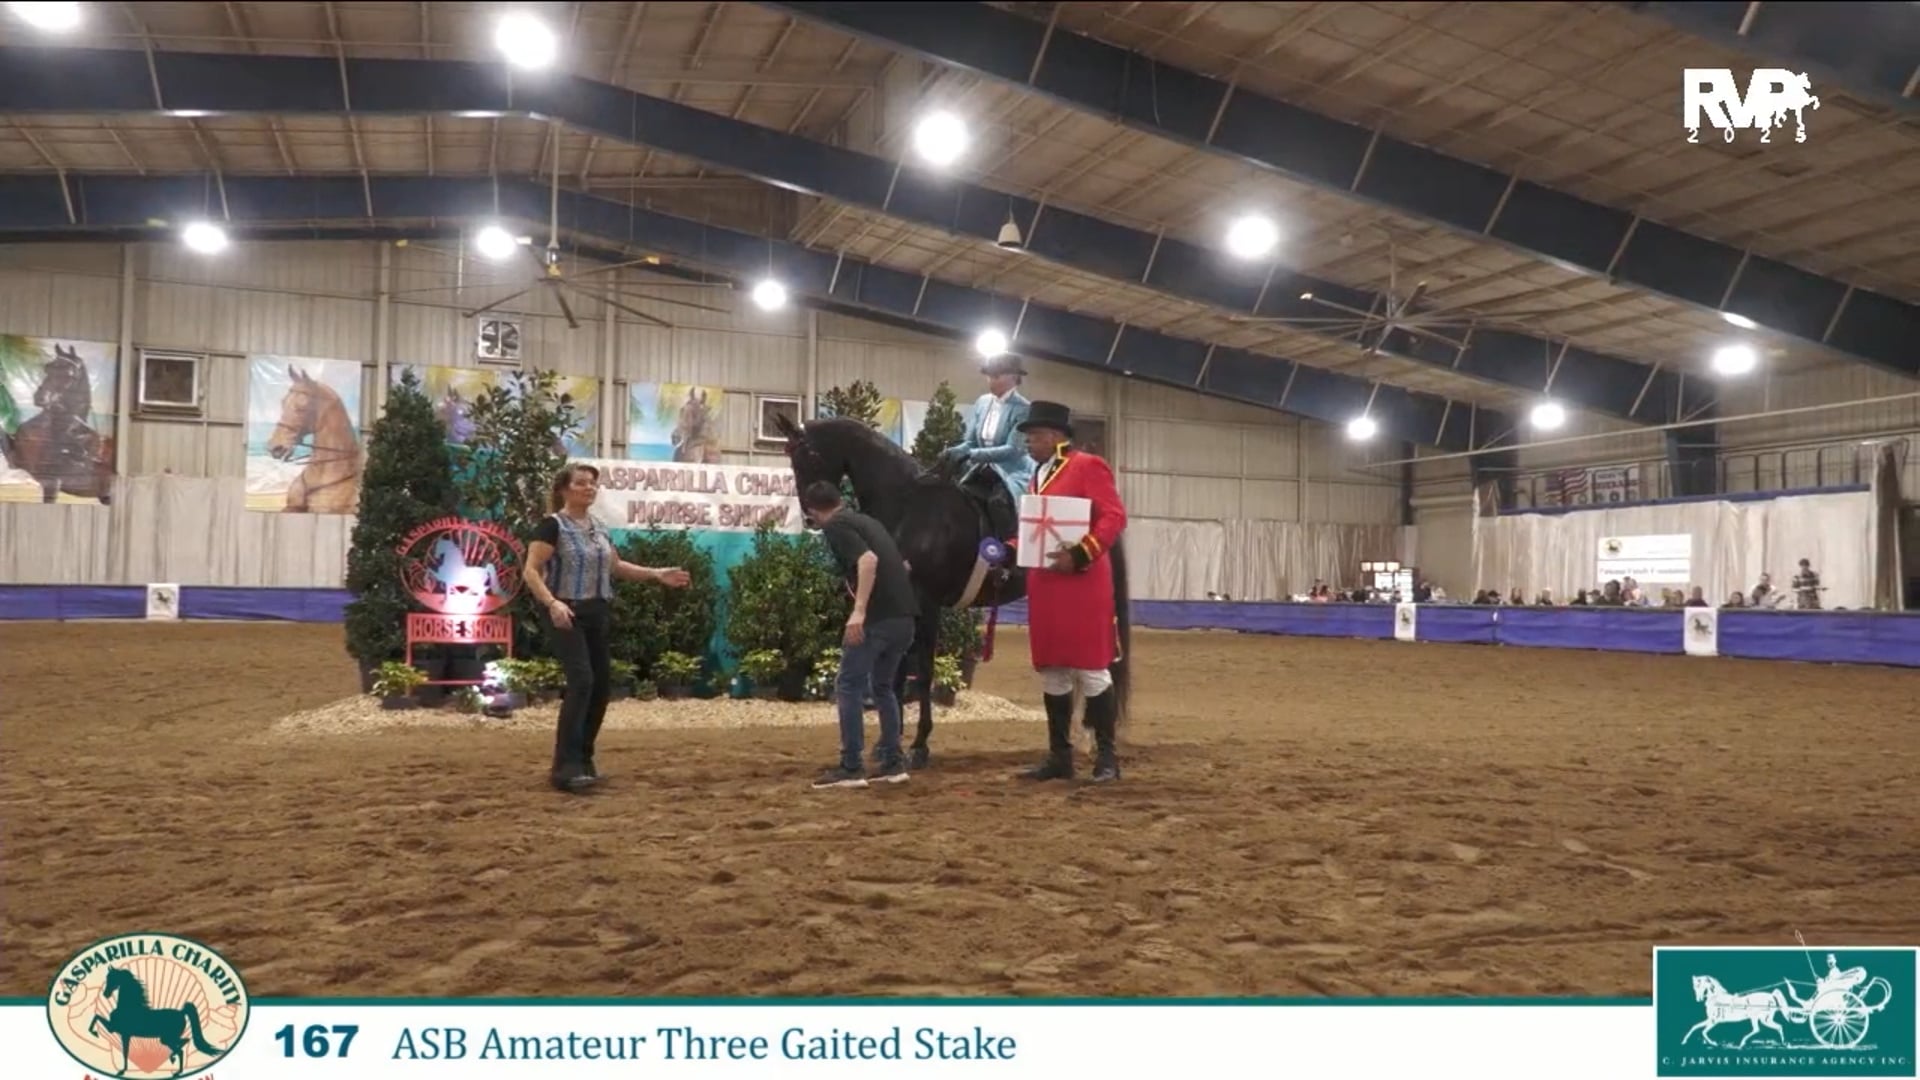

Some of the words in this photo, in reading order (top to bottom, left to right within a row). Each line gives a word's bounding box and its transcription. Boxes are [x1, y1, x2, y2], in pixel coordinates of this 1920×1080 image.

[597, 465, 729, 495] ASPARILLA
[735, 471, 799, 497] CHAR
[627, 500, 712, 526] HORSE
[718, 502, 790, 528] SHOW
[411, 618, 464, 639] HORSE
[464, 618, 510, 639] SHOW
